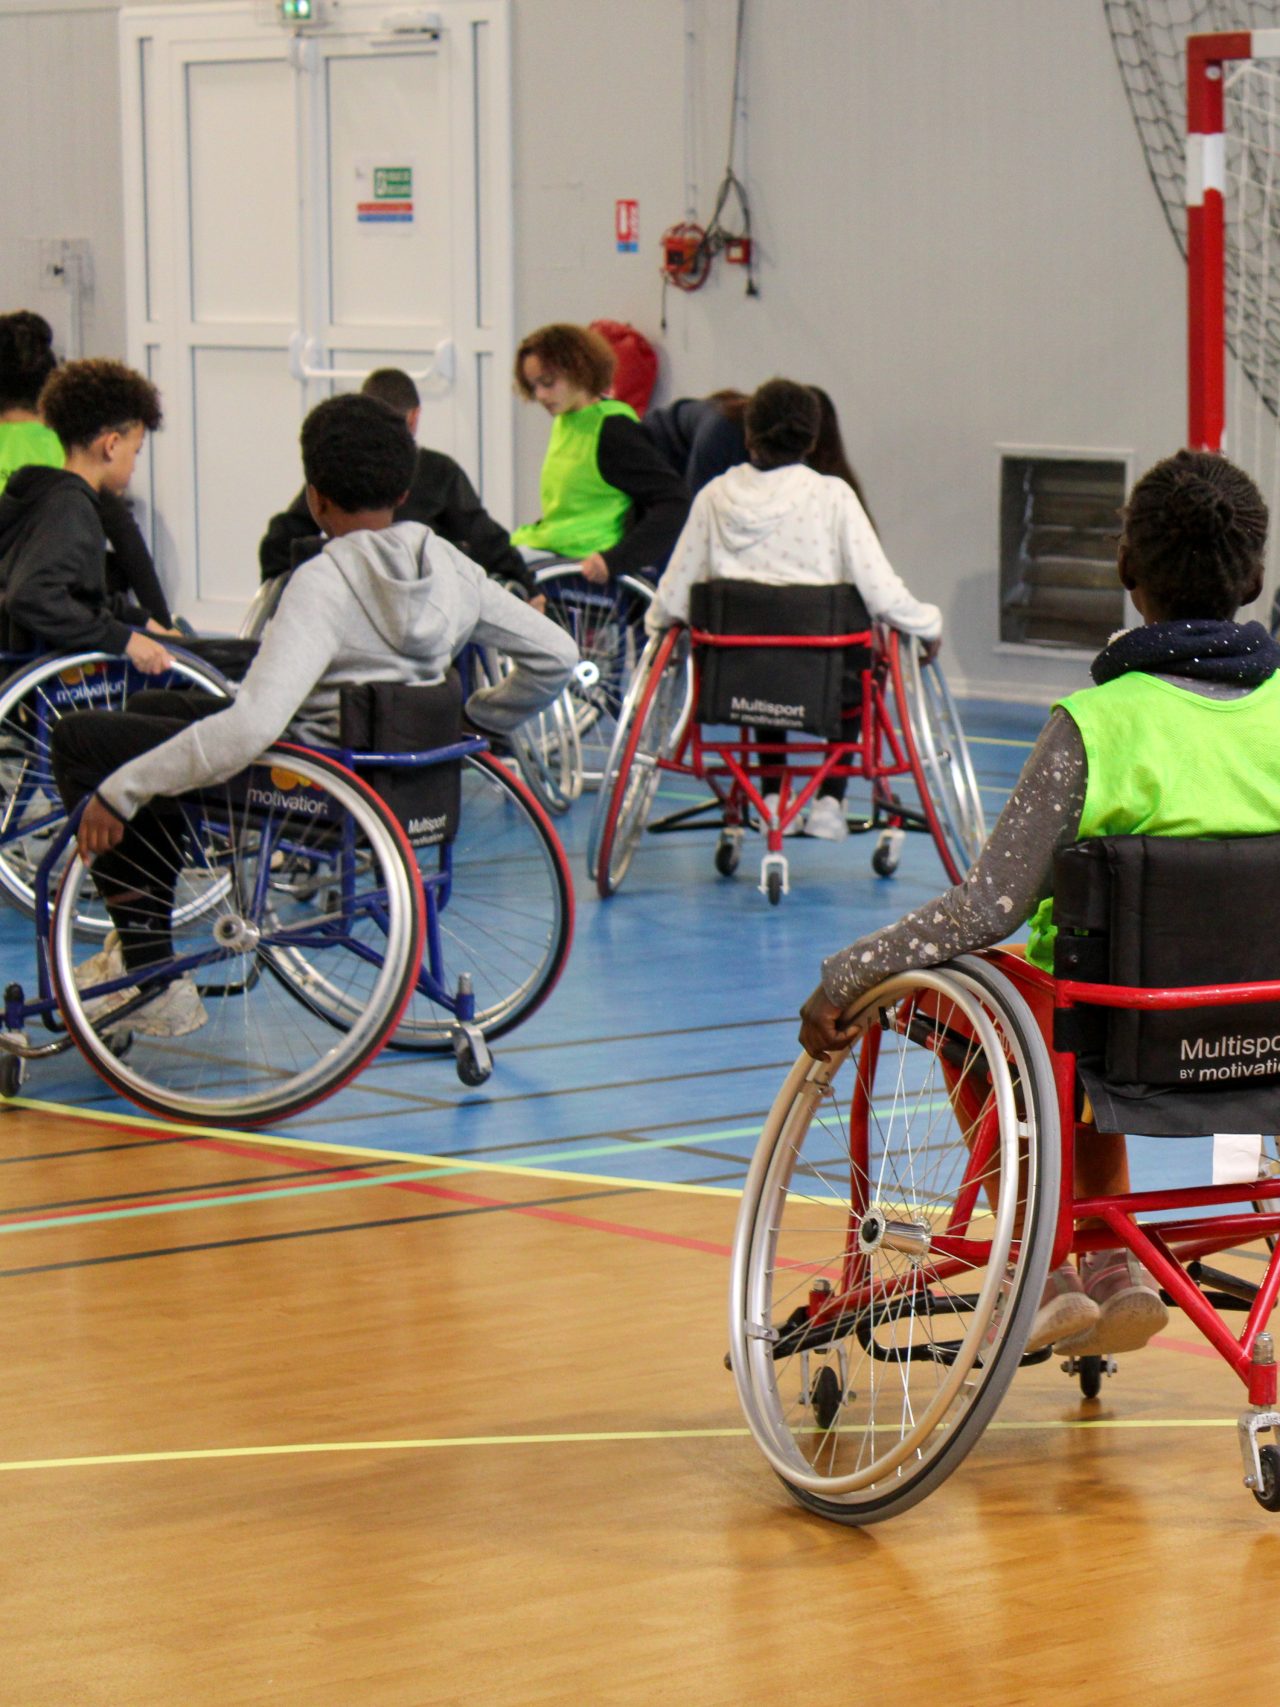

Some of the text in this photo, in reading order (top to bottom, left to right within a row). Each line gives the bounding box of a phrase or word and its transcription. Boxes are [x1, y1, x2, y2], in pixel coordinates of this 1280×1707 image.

[731, 696, 806, 718] Multisport
[246, 787, 329, 815] motivation
[408, 814, 447, 835] Multisport
[1180, 1068, 1195, 1080] BY
